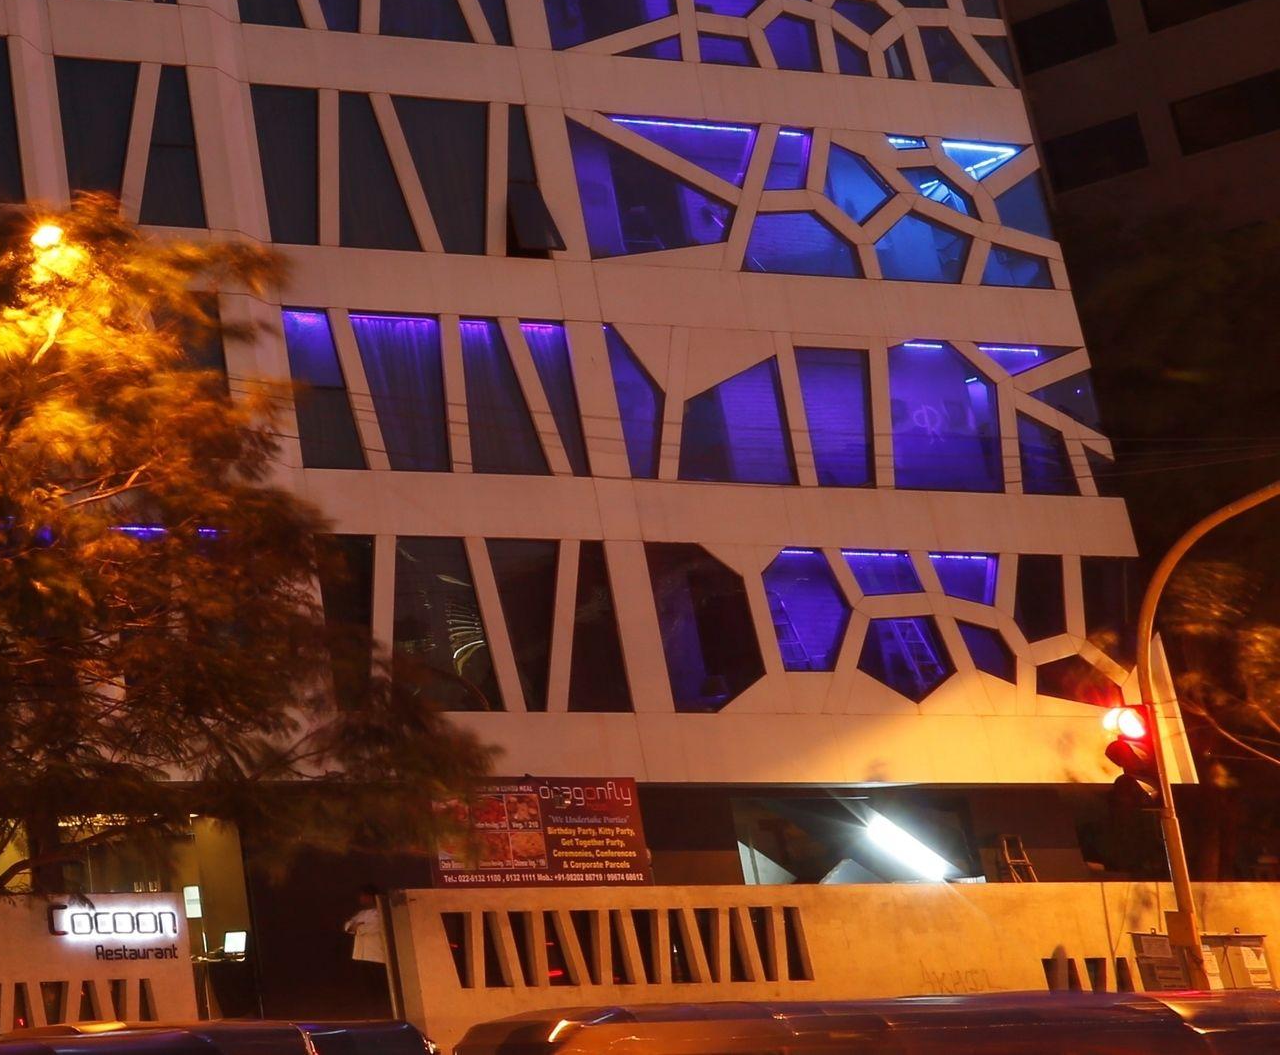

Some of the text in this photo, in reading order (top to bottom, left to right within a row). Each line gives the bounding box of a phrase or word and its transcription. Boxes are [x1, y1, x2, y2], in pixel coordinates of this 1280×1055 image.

[547, 826, 576, 836] Birthday
[599, 826, 614, 836] Kitty
[561, 838, 574, 846] Get
[575, 838, 604, 847] Together
[595, 849, 637, 858] Conferences
[570, 860, 603, 870] Corporate
[47, 904, 178, 936] Cocoon
[95, 944, 179, 961] Restaurant
